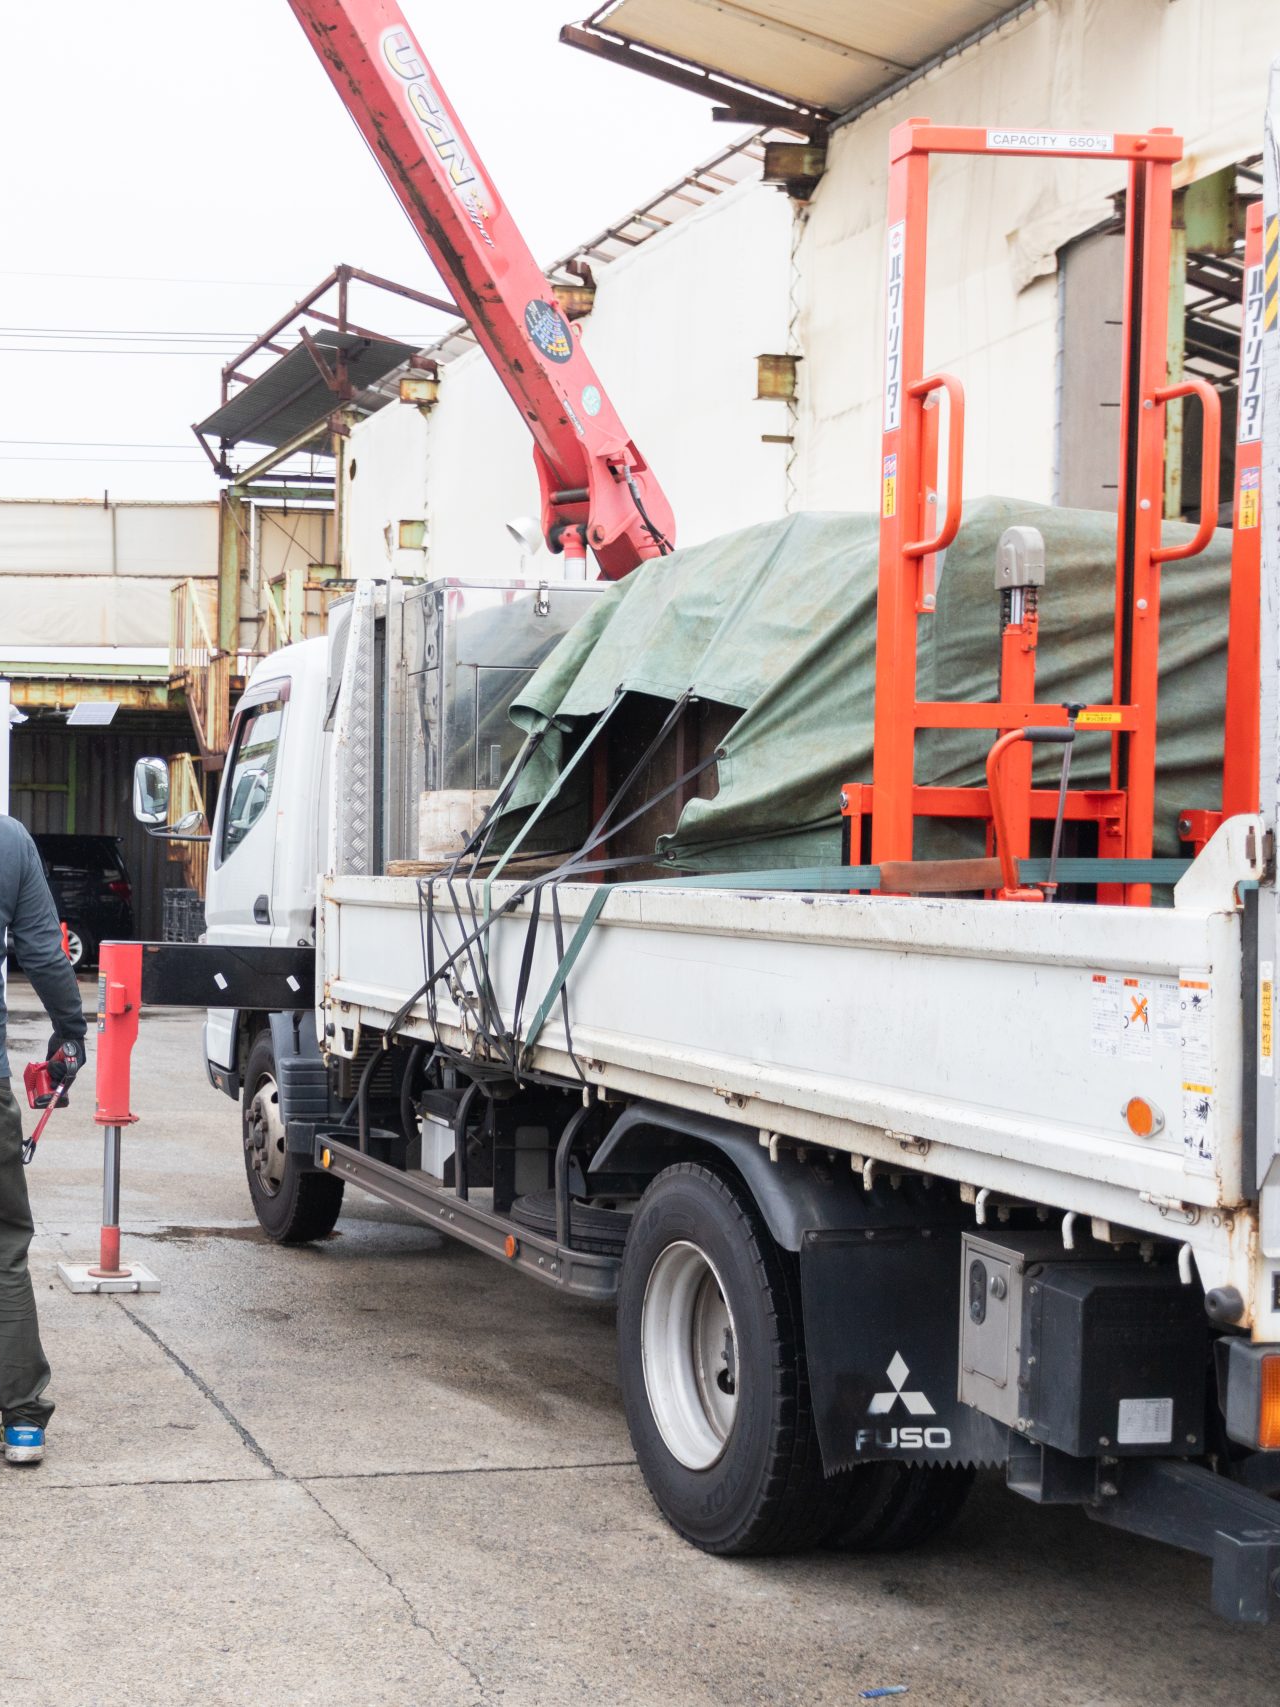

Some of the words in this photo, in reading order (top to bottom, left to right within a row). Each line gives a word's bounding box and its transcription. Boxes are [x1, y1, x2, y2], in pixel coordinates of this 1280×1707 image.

[993, 134, 1057, 146] CAPACITY
[1069, 137, 1107, 149] 650kg
[855, 1427, 952, 1451] FUSO
